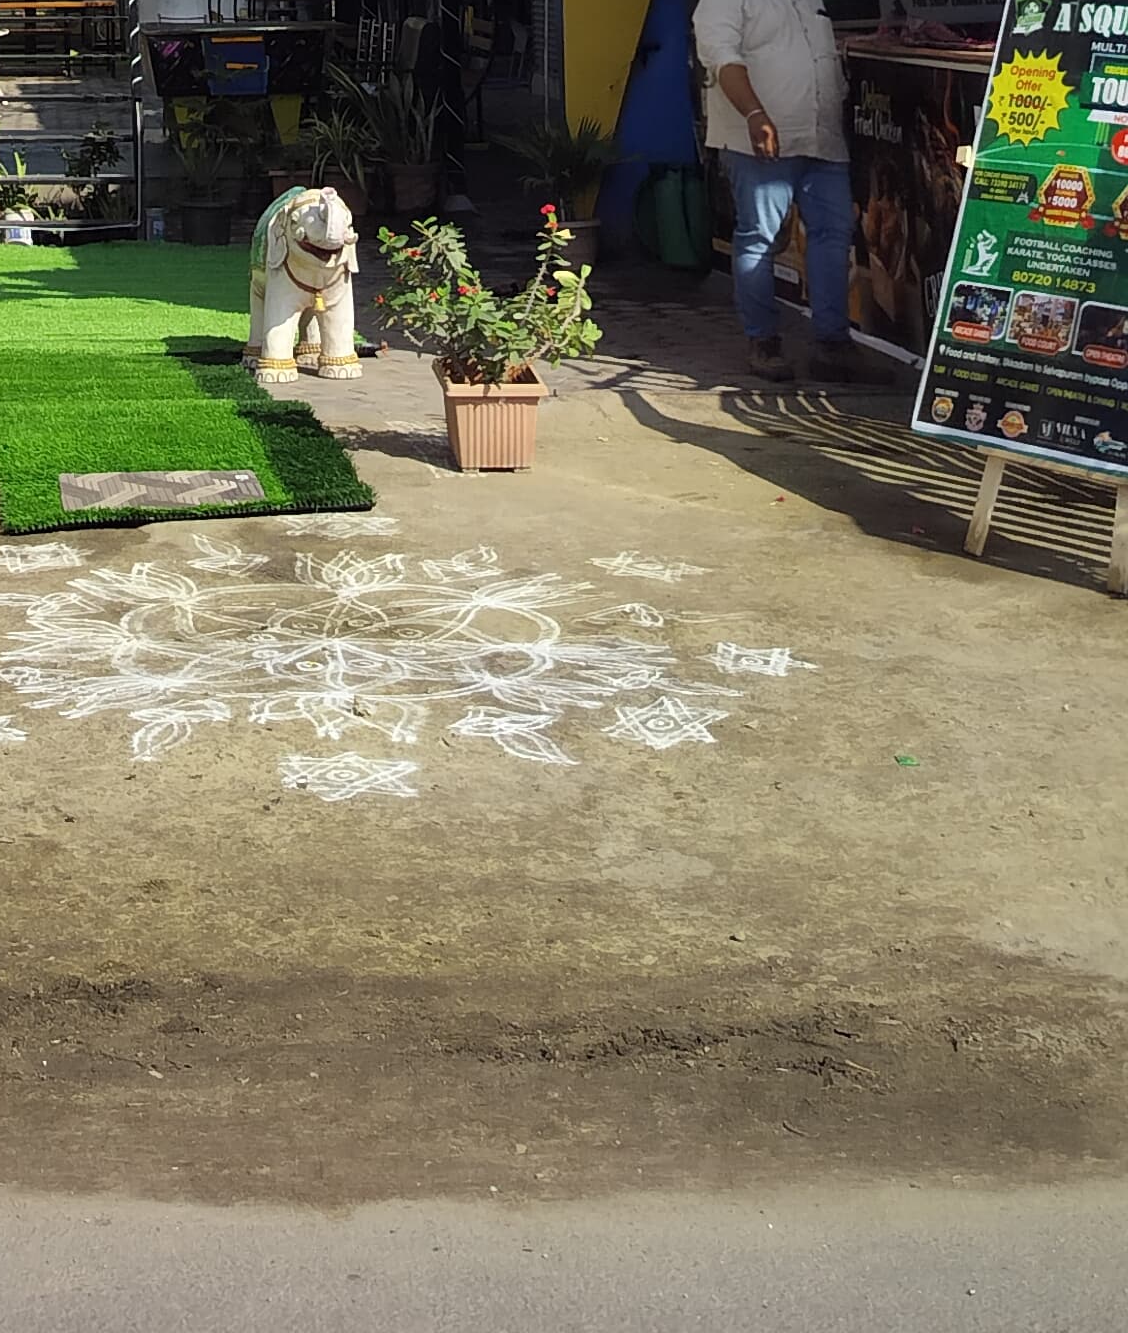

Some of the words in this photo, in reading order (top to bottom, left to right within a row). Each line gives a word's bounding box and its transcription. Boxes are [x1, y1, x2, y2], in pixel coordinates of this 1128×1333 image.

[1052, 2, 1071, 32] A
[1010, 65, 1057, 81] Opening
[1016, 80, 1043, 92] Offer
[1014, 237, 1060, 251] FOOTBALL
[1062, 241, 1113, 259] COACHING
[1027, 261, 1090, 277] UNDERTAKEN
[1047, 252, 1071, 264] YOGA
[1073, 257, 1117, 270] CLASSES
[1012, 271, 1052, 286] 80720
